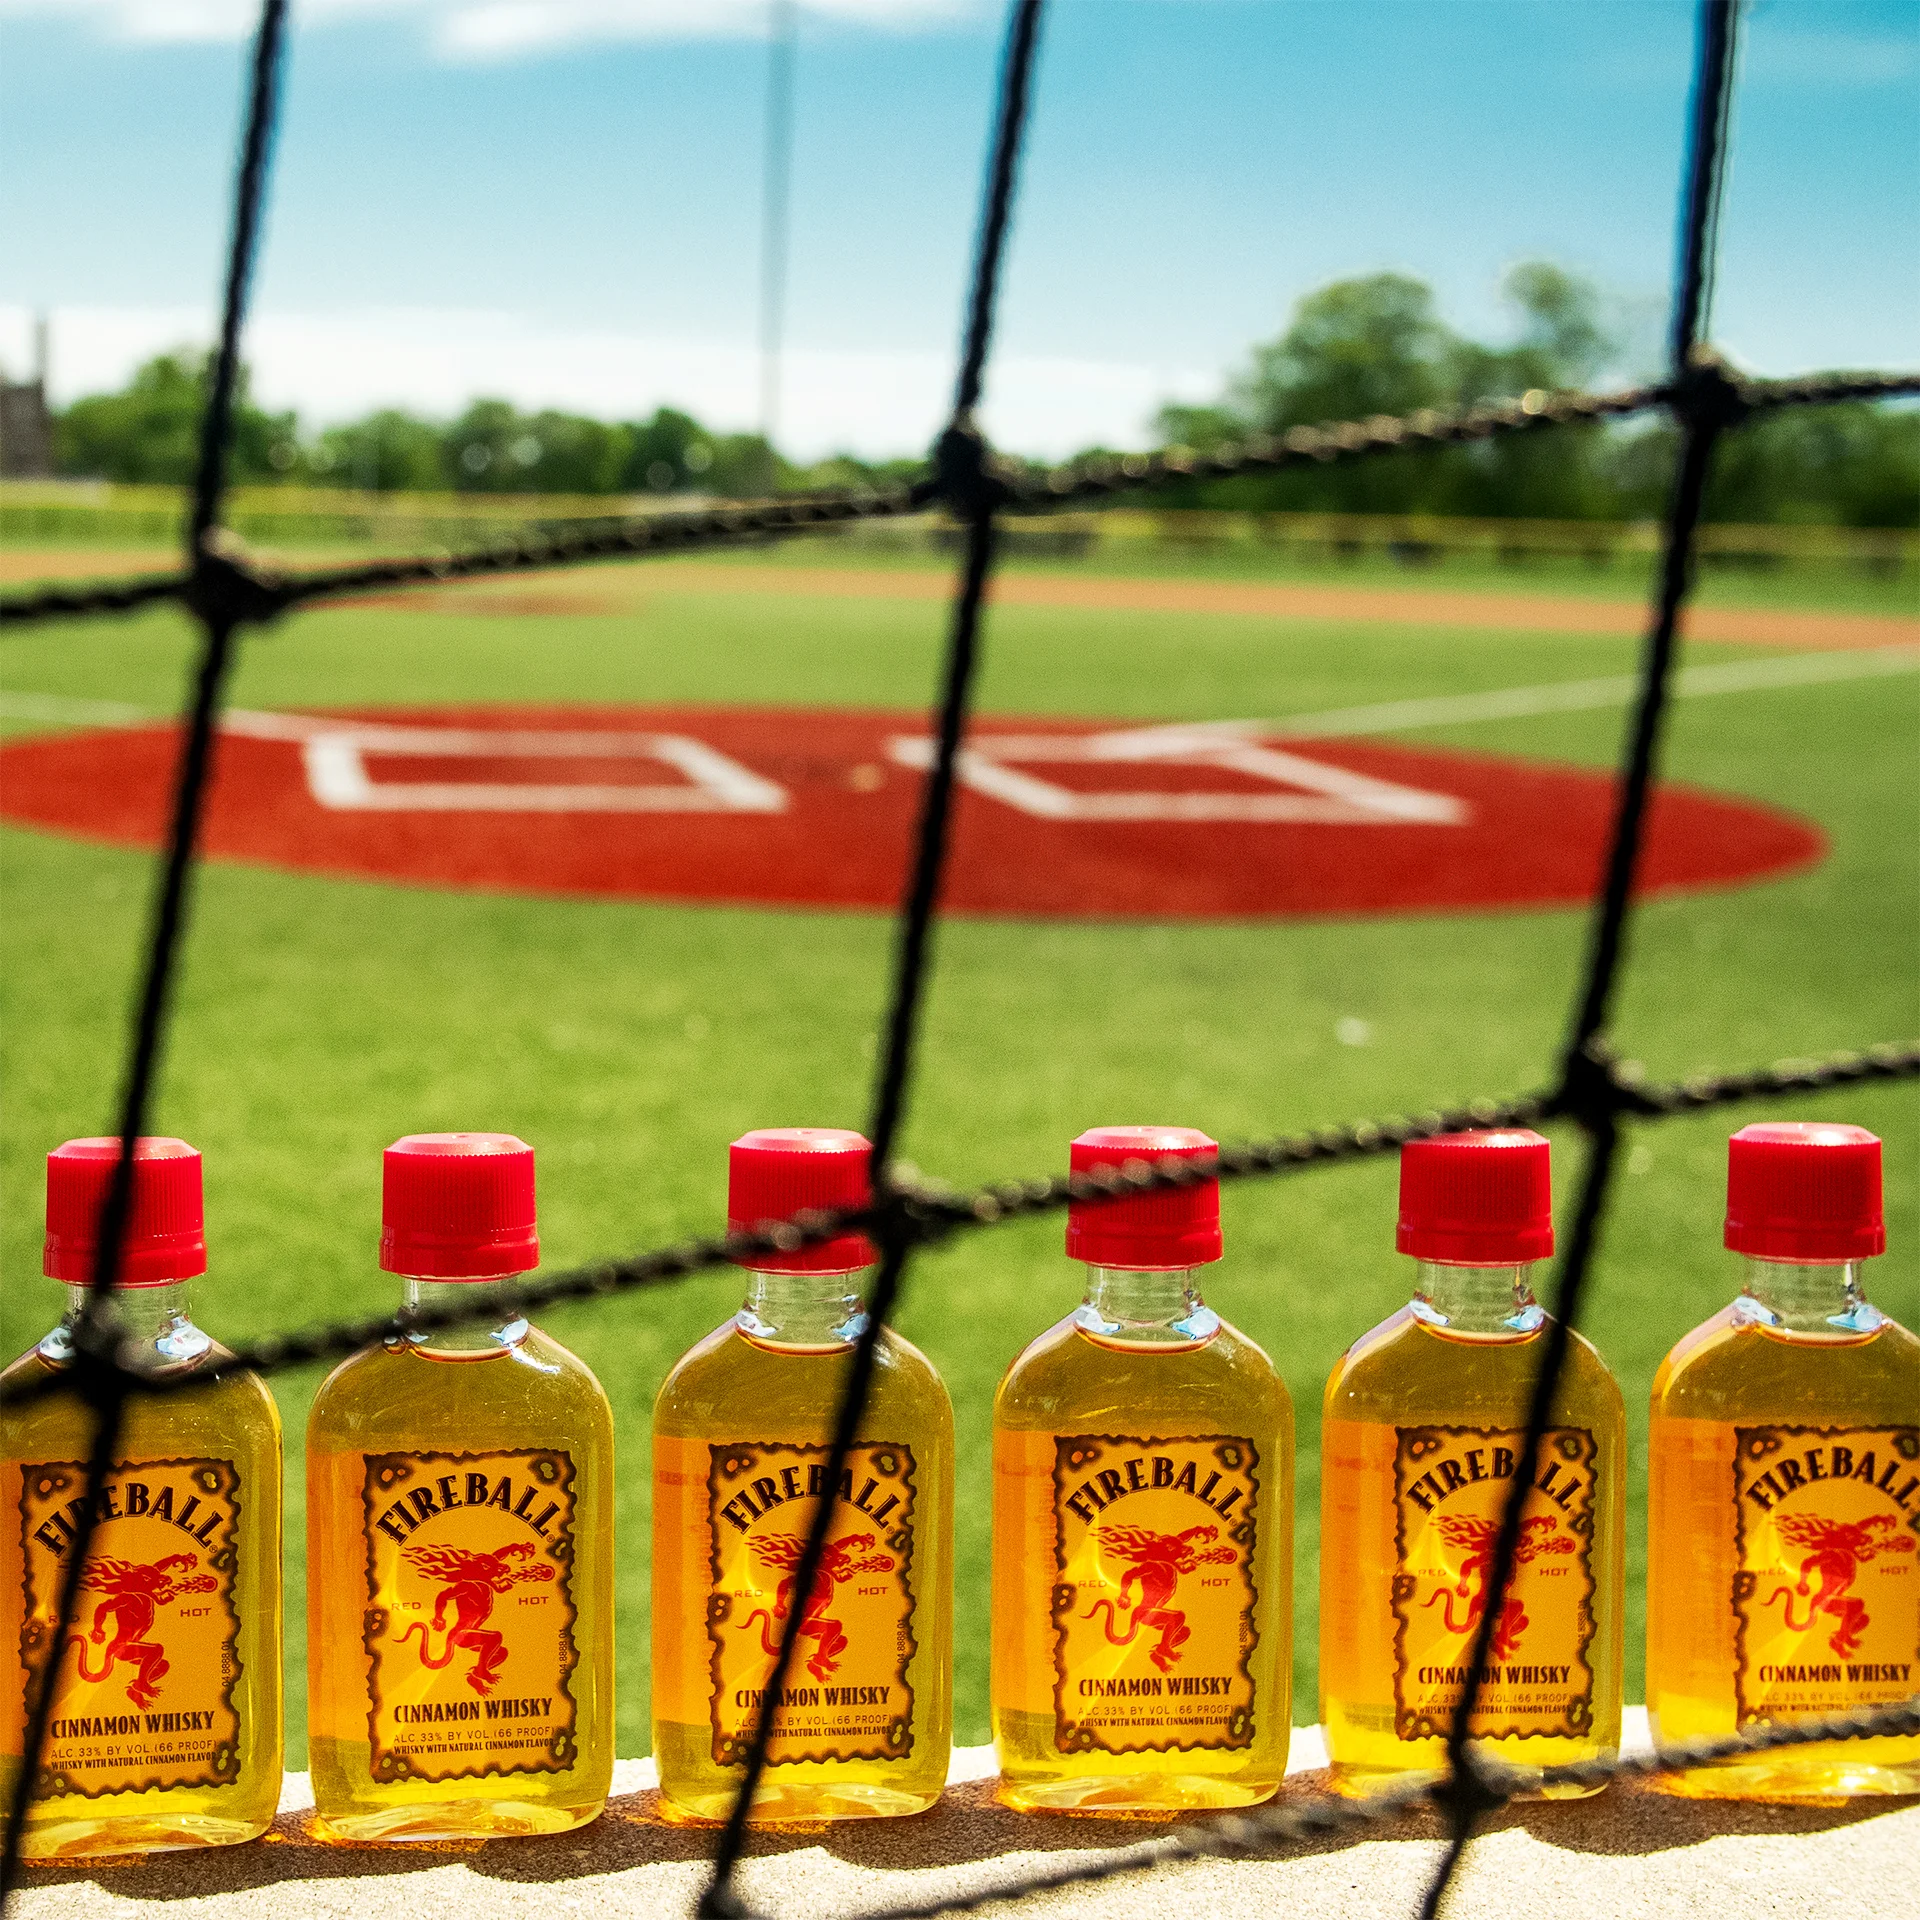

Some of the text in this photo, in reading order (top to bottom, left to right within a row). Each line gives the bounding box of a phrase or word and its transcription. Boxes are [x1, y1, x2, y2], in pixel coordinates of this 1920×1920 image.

[1406, 1447, 1582, 1515] FIREBLL
[1746, 1446, 1920, 1511] FIREBALL
[1066, 1457, 1243, 1525] FIREBALL
[376, 1473, 561, 1546] FIREBALL
[1539, 1568, 1569, 1576] HOT
[1078, 1578, 1231, 1588] RED HOT
[734, 1587, 889, 1599] RED HOT
[392, 1597, 549, 1611] RED HOT
[49, 1607, 212, 1624] RD HOT
[1418, 1665, 1571, 1685] CINNAON WHISKY
[1759, 1664, 1911, 1682] CINNAMON WHISKY
[1079, 1676, 1232, 1697] CINNAMON WHISKY
[735, 1686, 890, 1708] CINAMON WHISKY
[393, 1698, 552, 1723] CINNAMON WHISKY
[1130, 1706, 1144, 1715] BY
[1471, 1704, 1503, 1714] ATURAL
[51, 1711, 215, 1739] CINNAMON WHISKY
[787, 1717, 802, 1726] BY
[1109, 1717, 1130, 1727] WITH
[1131, 1717, 1164, 1727] NATURAL
[1165, 1716, 1204, 1726] CINNAMON
[447, 1731, 462, 1741] BY
[517, 1726, 555, 1737] PROOF)
[736, 1729, 767, 1739] WHIS
[768, 1728, 787, 1738] ITH
[788, 1726, 822, 1737] NATURAL
[823, 1725, 862, 1736] CINNAMON
[107, 1745, 121, 1755] BY
[178, 1739, 217, 1751] PROOF)
[394, 1744, 424, 1755] WHISKY
[426, 1742, 448, 1753] WITH
[448, 1740, 484, 1752] NATURAL
[485, 1738, 524, 1750] CINNAMON
[51, 1759, 82, 1771] WHISKY
[85, 1757, 107, 1768] WITH
[108, 1755, 144, 1767] NATURAL
[145, 1752, 186, 1764] CINNAMON
